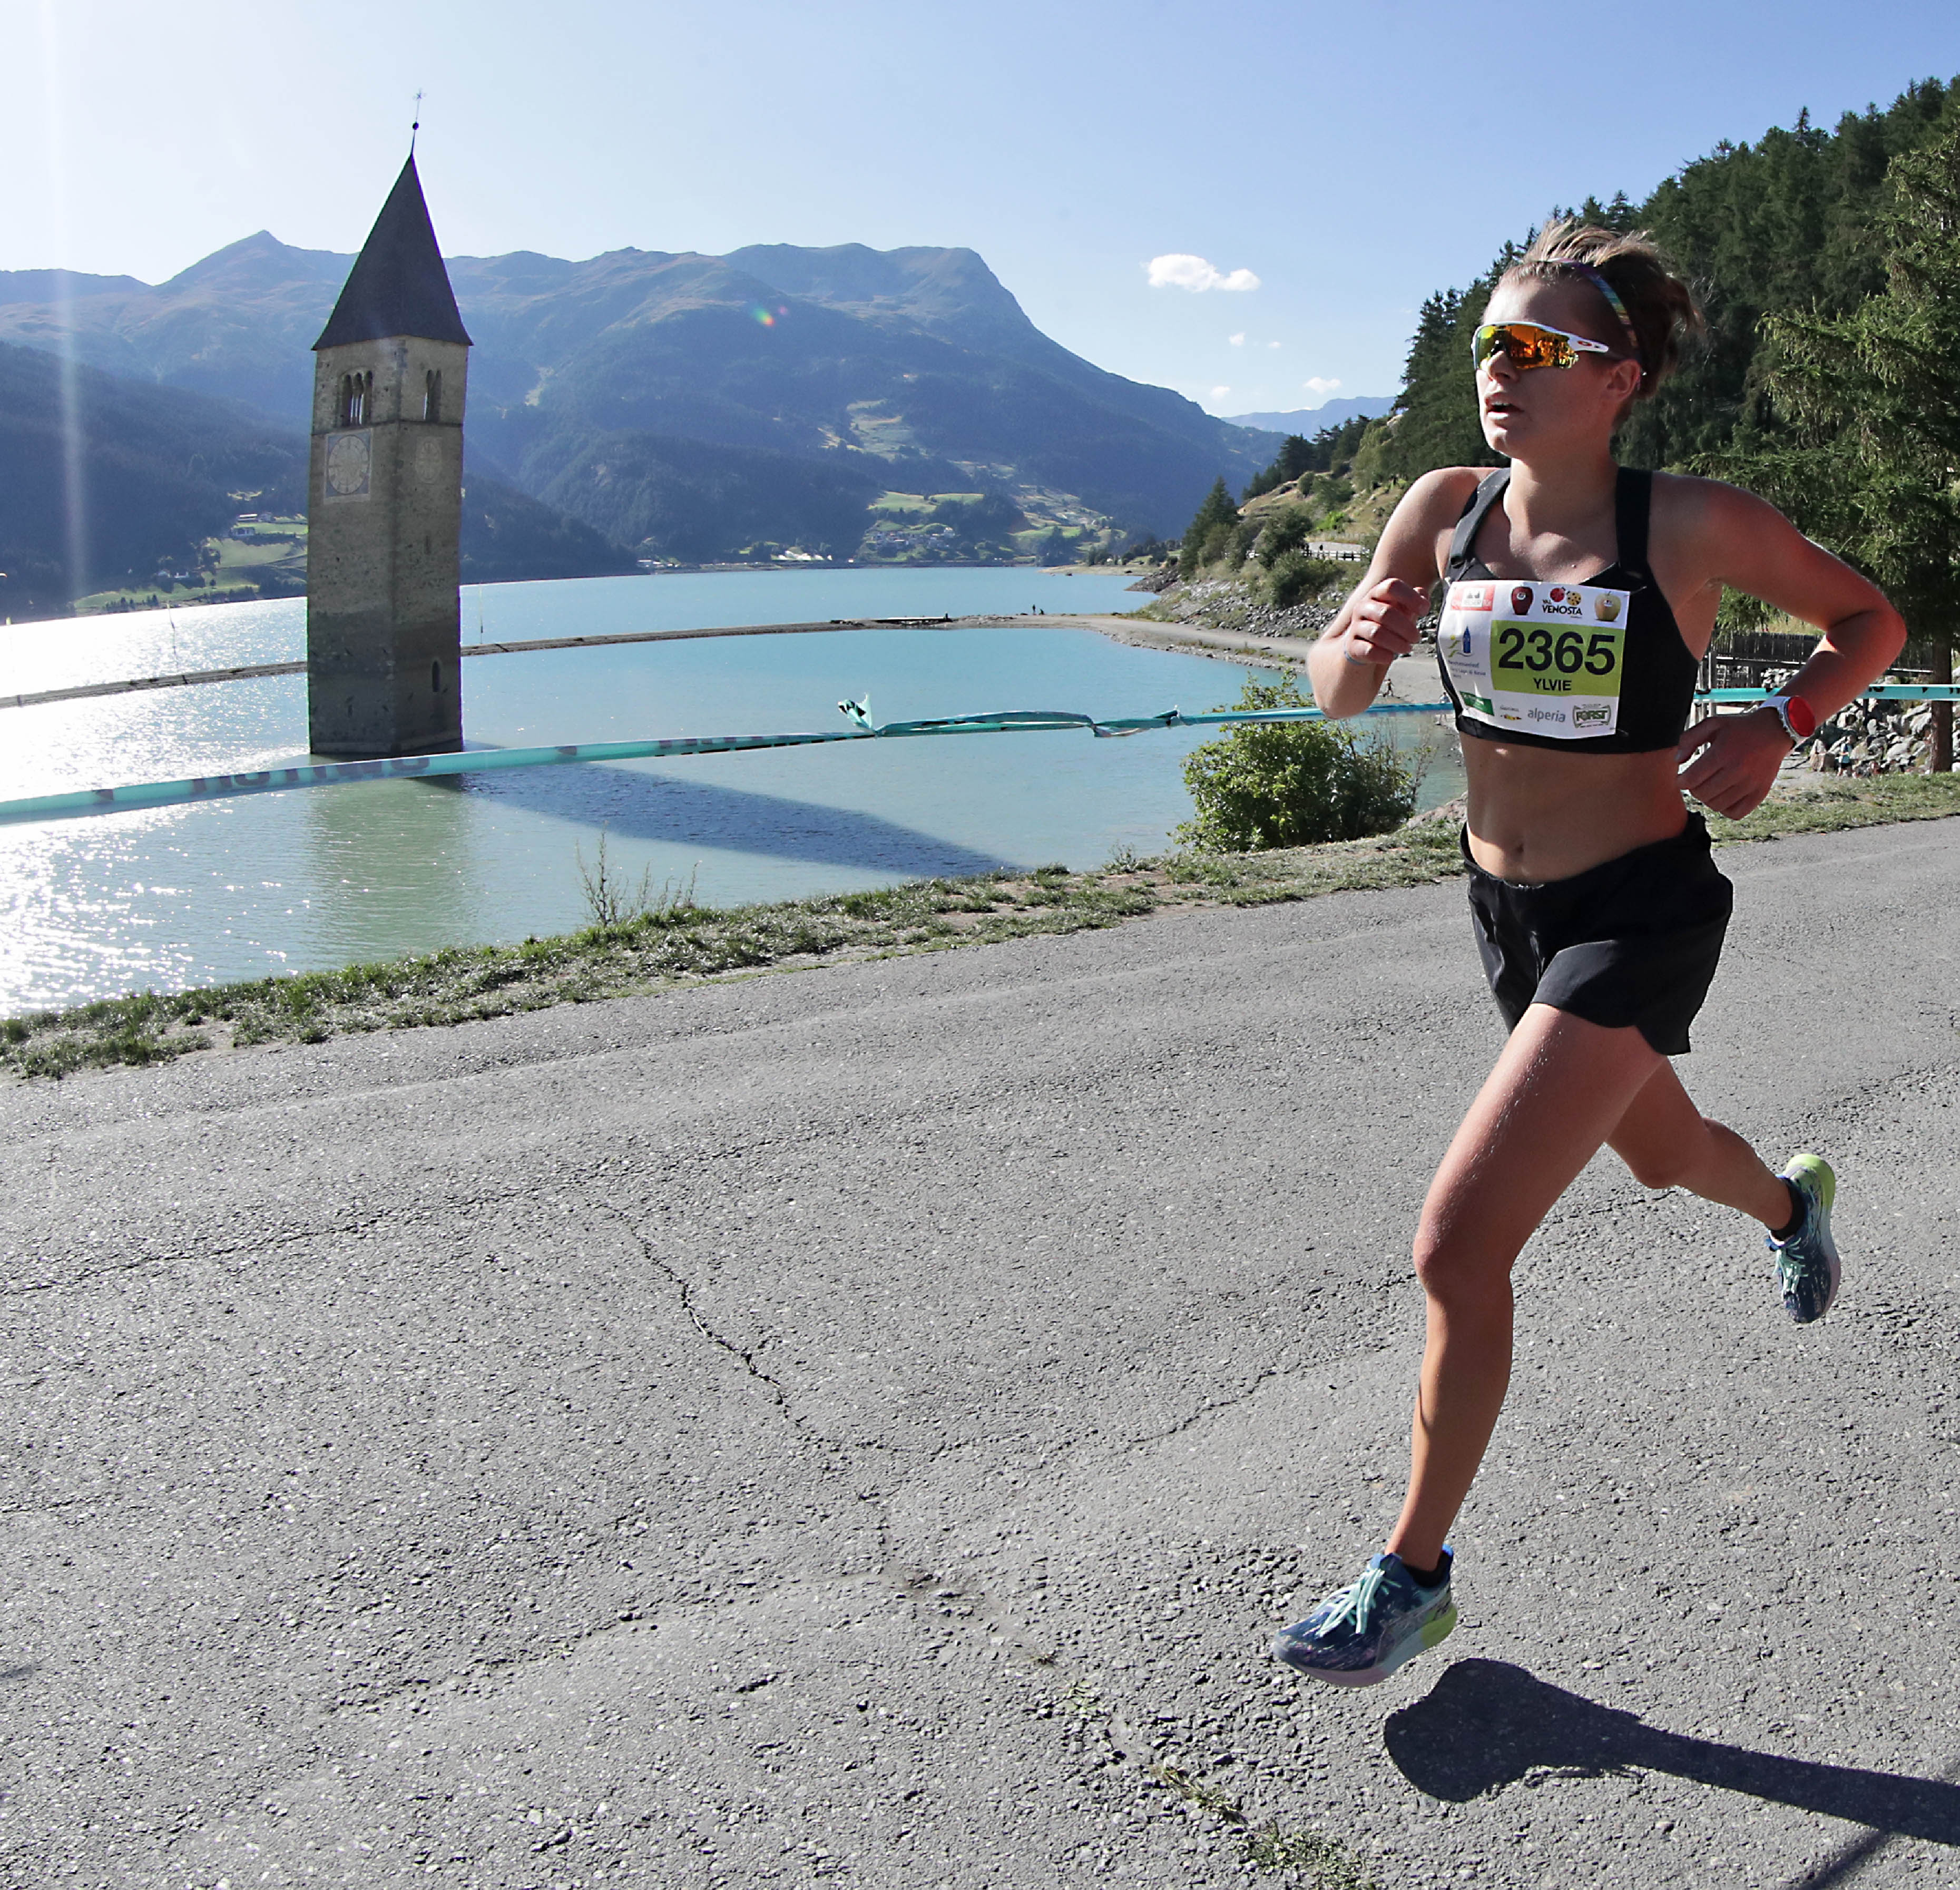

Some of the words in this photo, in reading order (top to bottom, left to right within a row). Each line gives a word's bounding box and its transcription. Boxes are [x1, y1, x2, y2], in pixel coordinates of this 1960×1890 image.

[1542, 604, 1583, 615] VENOSTA
[1498, 628, 1615, 675] 2365
[1533, 678, 1572, 691] YLVIE
[1527, 708, 1566, 722] alperia
